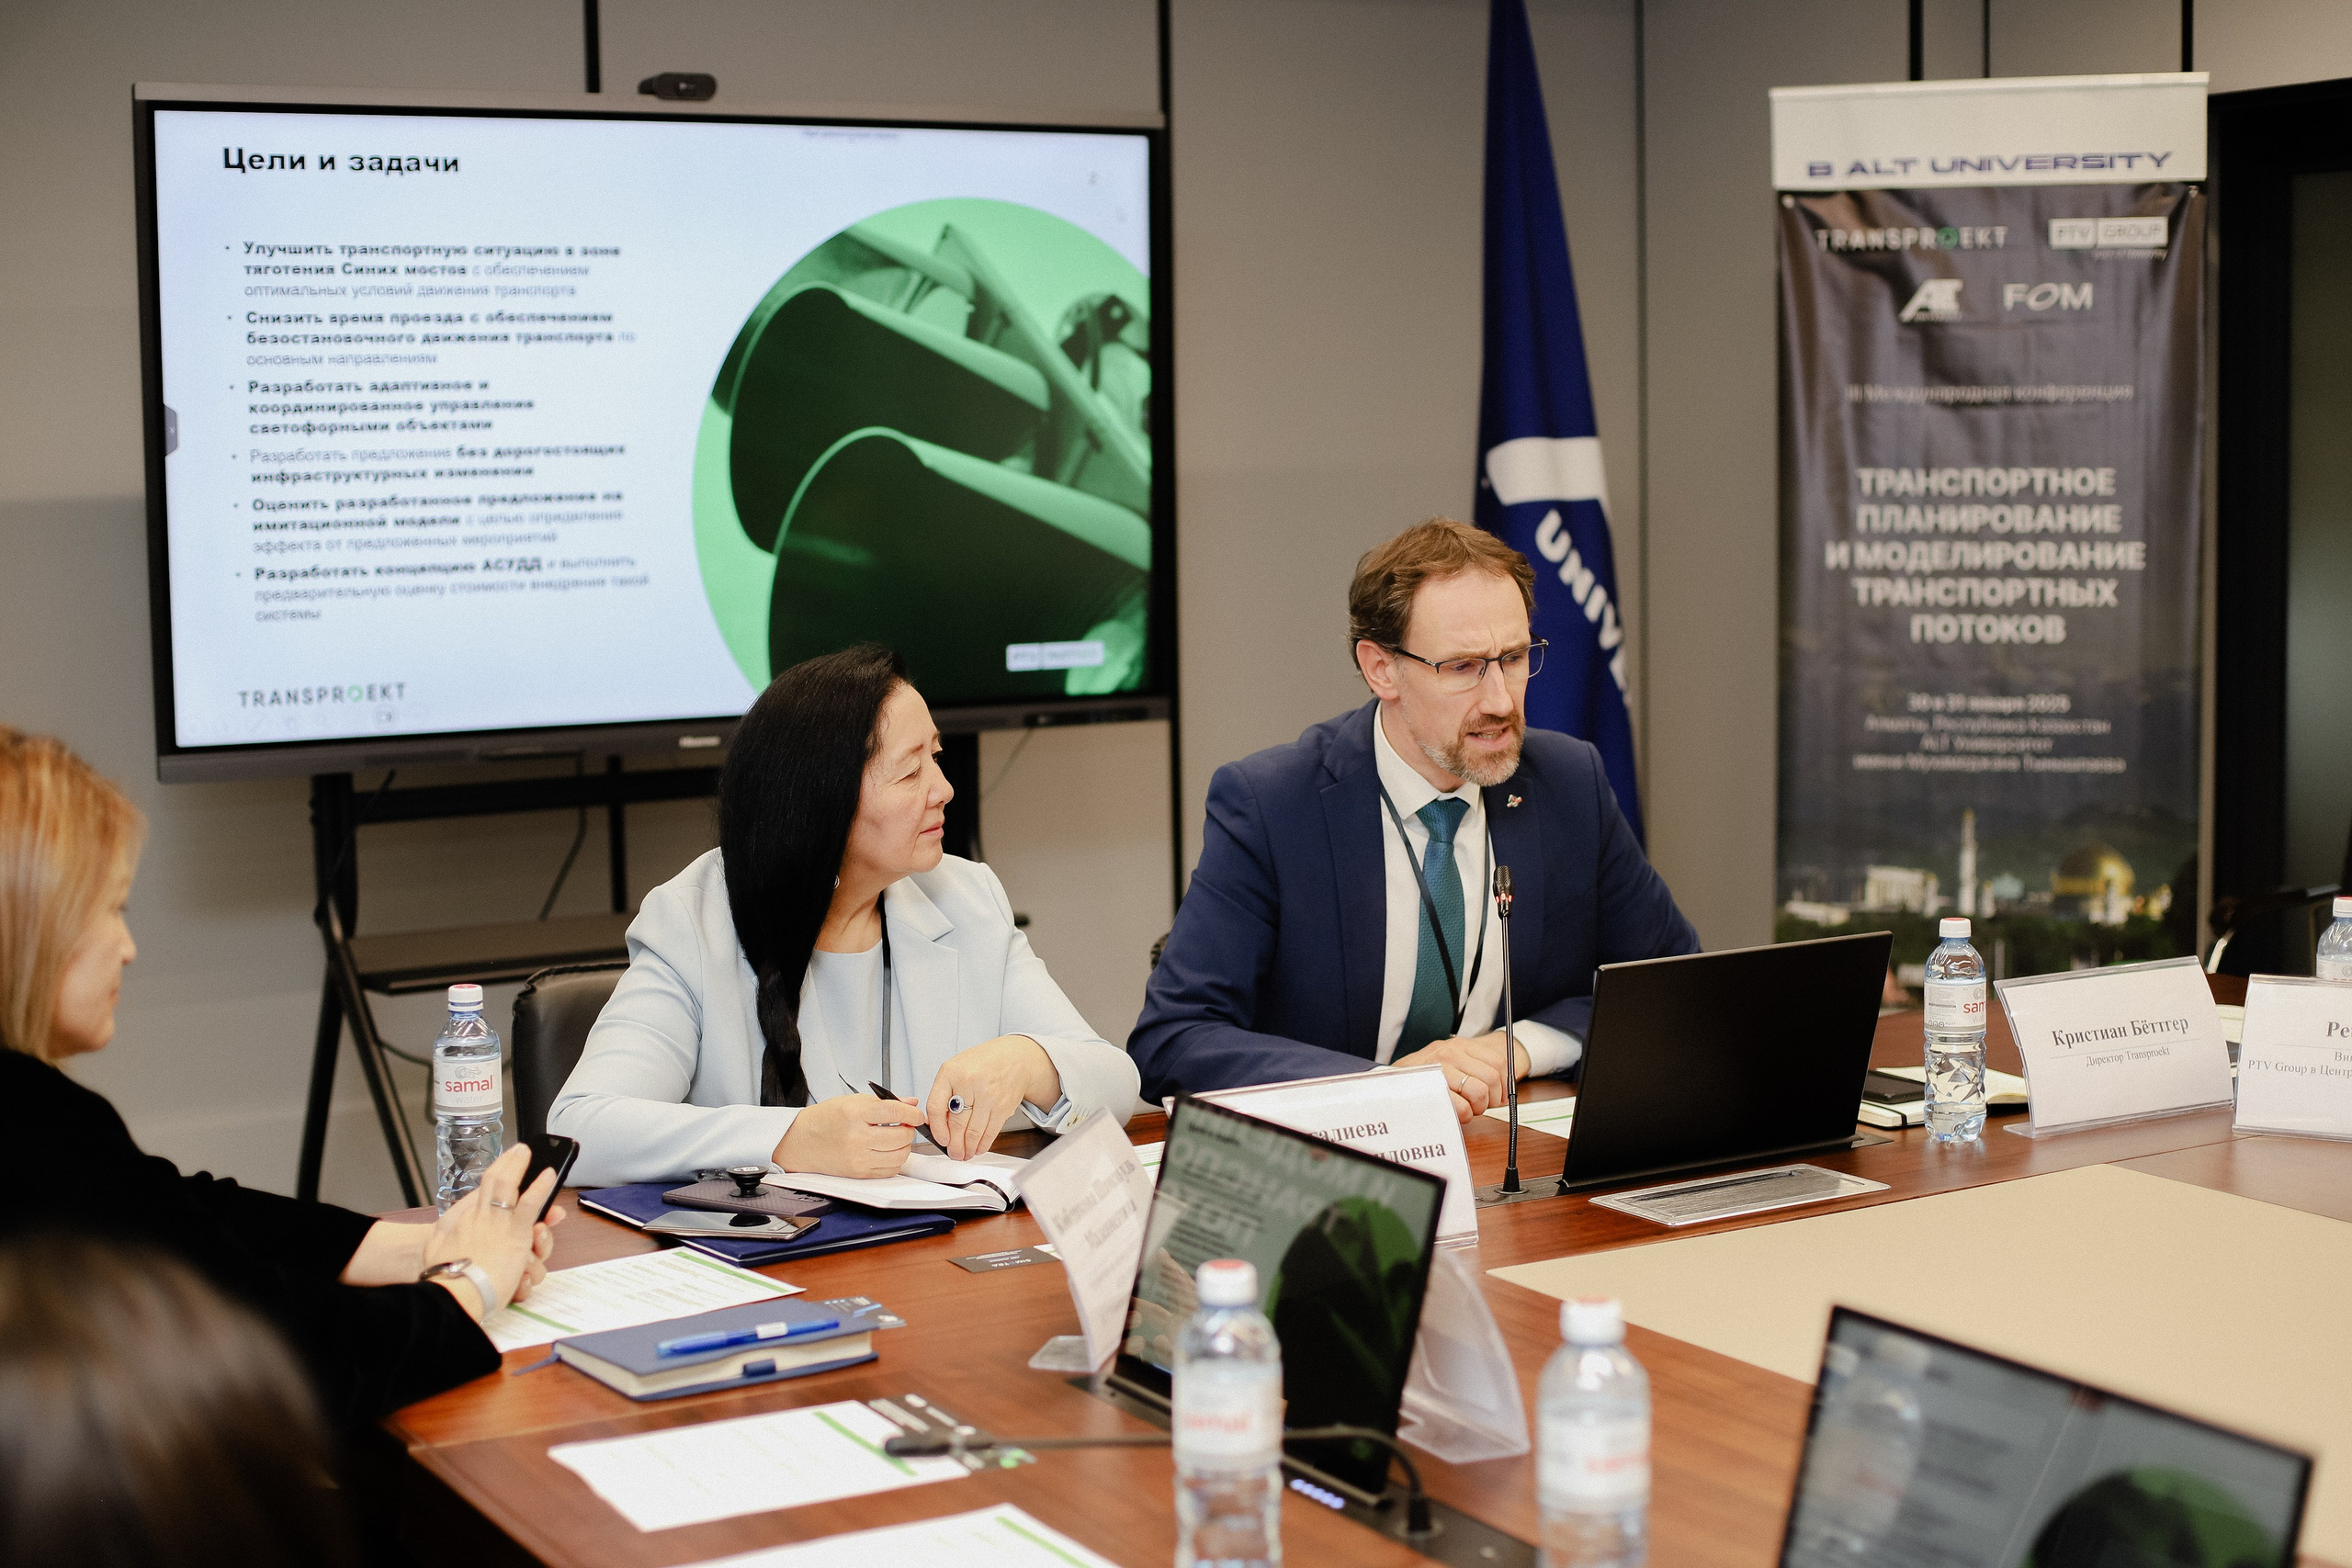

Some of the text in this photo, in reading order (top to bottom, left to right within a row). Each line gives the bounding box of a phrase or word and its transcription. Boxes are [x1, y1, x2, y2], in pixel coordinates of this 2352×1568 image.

[223, 147, 459, 175] Цели и задачи
[1847, 158, 1918, 175] ALT
[1931, 151, 2173, 175] UNIVERSITY
[1814, 226, 2008, 253] TRANSPROEKT
[243, 241, 621, 259] Улучшить транспортную ситуацию в зоне
[244, 264, 334, 276] тяготения
[342, 262, 398, 276] Синих
[404, 265, 467, 275] мостов
[484, 261, 590, 276] обеспечением
[244, 285, 346, 298] оптимальных
[352, 283, 413, 299] условий
[495, 286, 577, 299] транспорта
[246, 310, 613, 327] Снизить время проезда с обеспечением
[247, 332, 415, 344] безостановочного
[421, 332, 509, 344] движения
[516, 333, 614, 346] транспорта
[246, 355, 322, 367] основным
[248, 379, 489, 396] Разработать адаптивное и
[249, 400, 535, 415] координированное управление
[250, 419, 492, 435] светофорными объектами
[250, 447, 346, 465] Разработать
[457, 444, 488, 457] без
[252, 468, 427, 485] инфраструктурных
[1856, 466, 2117, 497] ТРАНСПОРТНОЕ
[253, 498, 329, 512] Оценить
[253, 514, 387, 531] имитационной
[393, 515, 459, 527] модели
[1856, 502, 2123, 534] ПЛАНИРОВАНИЕ
[1825, 540, 2147, 575] И МОДЕЛИРОВАНИЕ
[255, 563, 368, 581] Разработать
[375, 560, 476, 574] концепцию
[483, 556, 543, 573] АСУДД
[1851, 576, 2120, 608] ТРАНСПОРТНЫХ
[1910, 613, 2067, 644] ПОТОКОВ
[237, 682, 406, 709] TRANSPROEKT
[2052, 1017, 2189, 1049] Кристиан Бёттгер
[2326, 1021, 2352, 1039] Ре
[2086, 1046, 2171, 1067] Директор Transproekt
[2248, 1059, 2272, 1070] PTV
[2275, 1062, 2308, 1076] Group
[445, 1074, 493, 1093] samal
